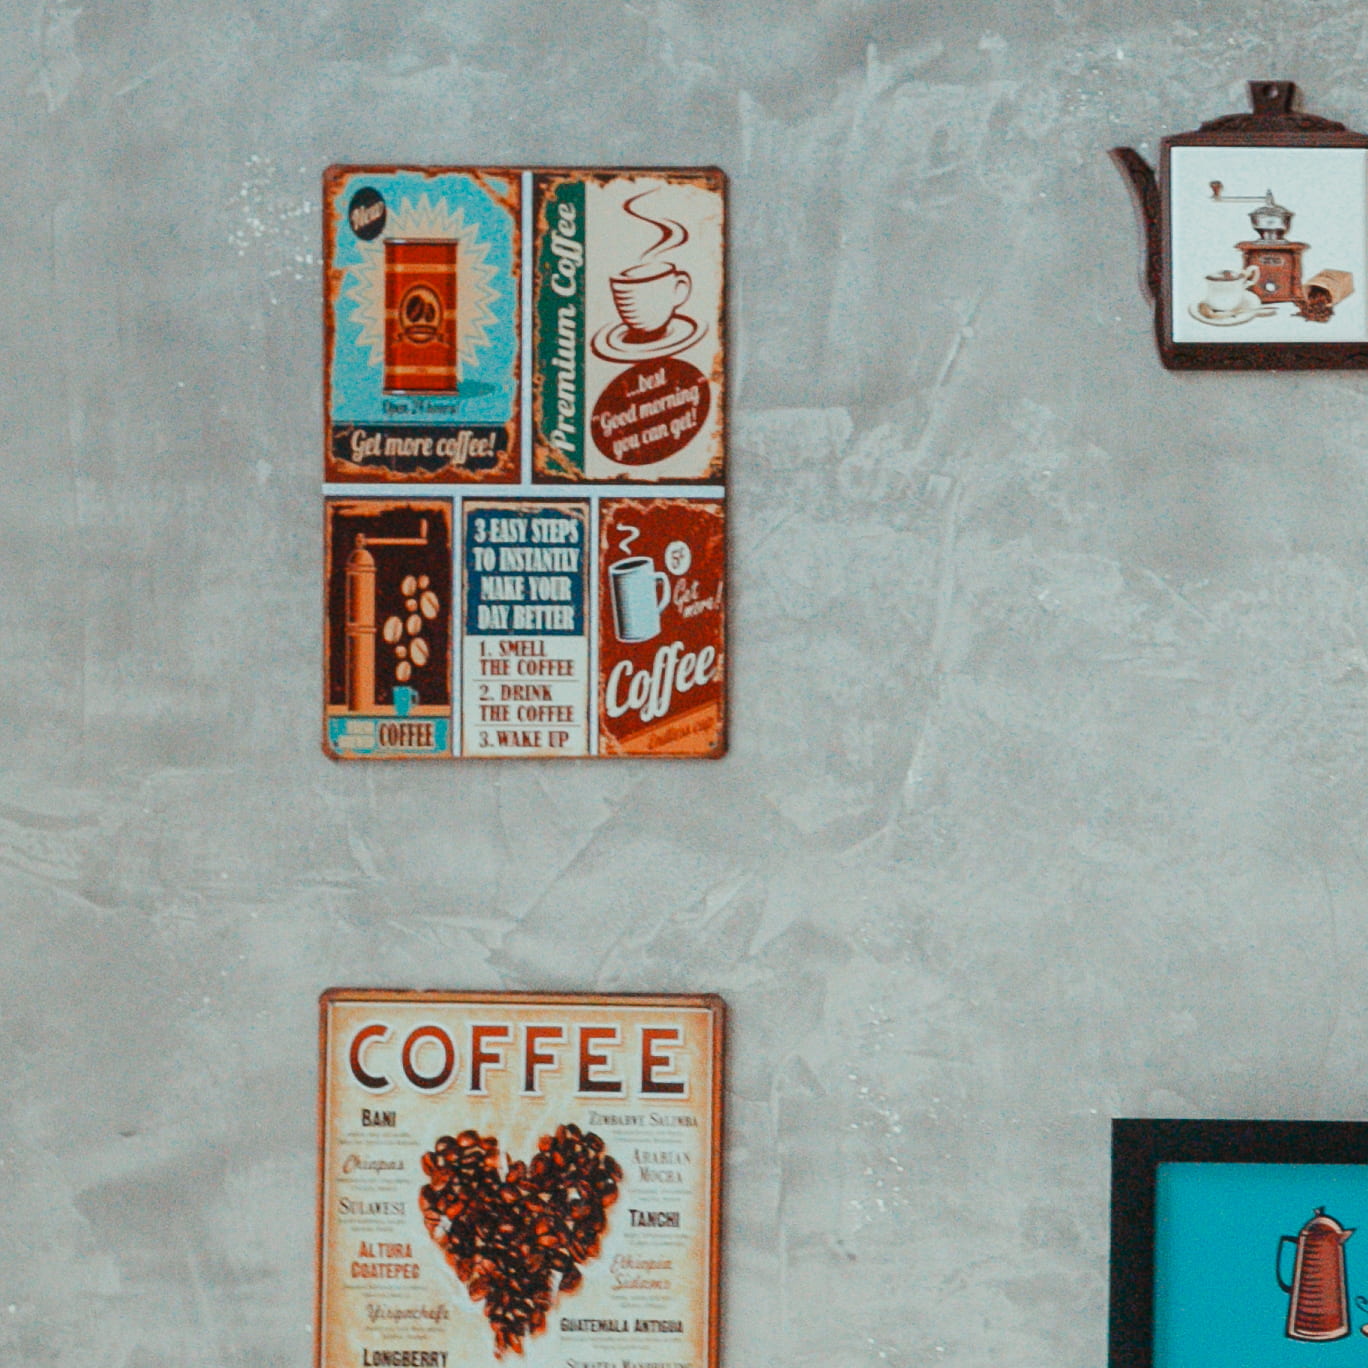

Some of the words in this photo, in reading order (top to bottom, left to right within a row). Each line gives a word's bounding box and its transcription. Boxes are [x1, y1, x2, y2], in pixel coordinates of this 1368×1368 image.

[551, 202, 583, 297] Coffee
[551, 303, 577, 452] Premium
[600, 403, 637, 437] Good
[639, 385, 699, 420] morning
[351, 429, 381, 463] Get
[384, 437, 434, 456] more
[436, 430, 496, 464] coffee!
[613, 433, 640, 461] you
[642, 424, 669, 444] can
[670, 407, 697, 440] get!
[474, 518, 486, 543] 3
[488, 518, 528, 543] EASY
[531, 518, 579, 543] STEPS
[472, 546, 496, 572] TO
[499, 546, 580, 572] INSTANTLY
[481, 576, 525, 601] MAKE
[528, 576, 572, 601] YOUR
[673, 577, 699, 613] Get
[477, 604, 510, 630] DAY
[513, 604, 575, 630] BETTER
[480, 640, 492, 657] 1.
[499, 640, 548, 657] SMELL
[479, 659, 511, 676] THE
[517, 659, 575, 676] COFFEE
[479, 684, 495, 701] 2.
[500, 684, 553, 701] DRINK
[605, 641, 716, 722] Coffee
[479, 705, 511, 722] THE
[517, 705, 575, 722] COFFEE
[378, 722, 435, 748] COFFEE
[496, 731, 542, 748] WAKE
[548, 731, 570, 748] UP
[347, 1022, 687, 1096] COFFEE
[560, 1317, 630, 1333] GUATEMALA
[362, 1347, 449, 1368] LONGBERRY
